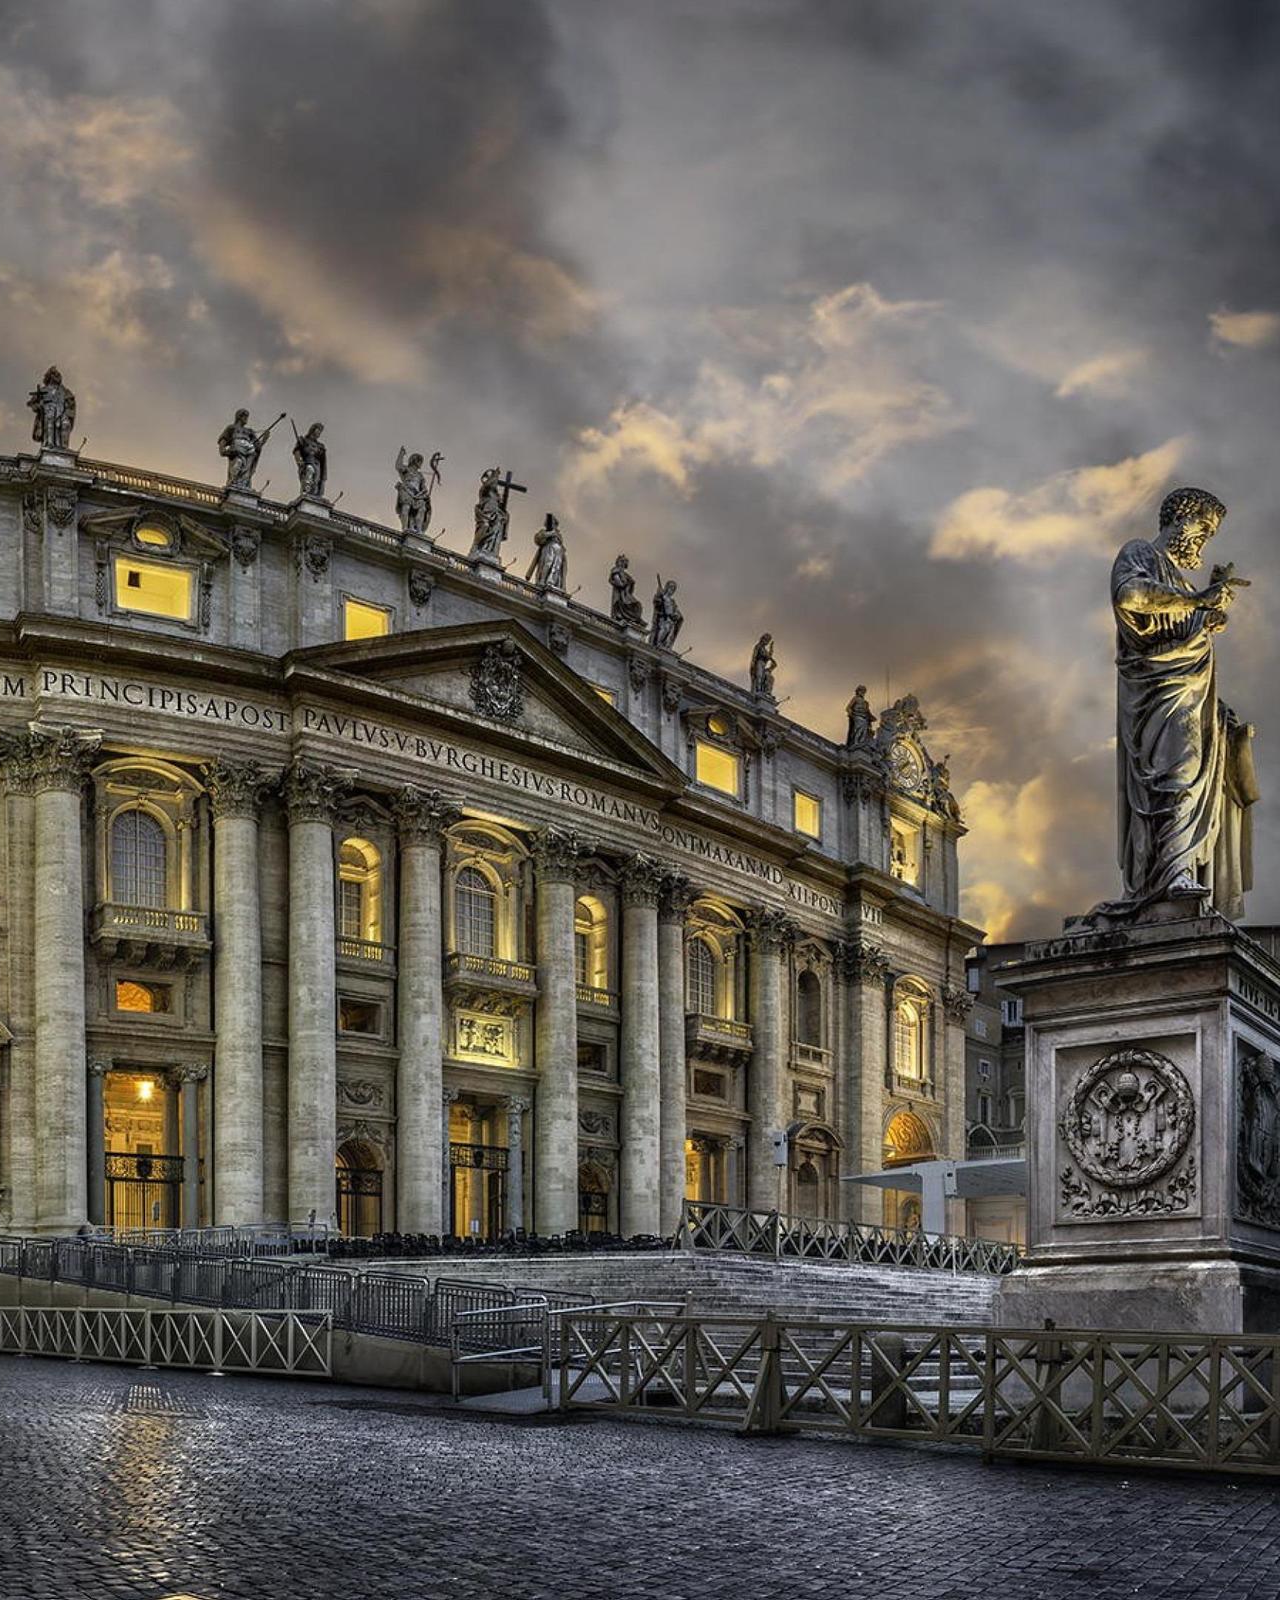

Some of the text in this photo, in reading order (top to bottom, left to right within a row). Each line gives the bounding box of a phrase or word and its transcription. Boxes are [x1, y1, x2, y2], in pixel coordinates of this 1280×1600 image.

[43, 671, 198, 715] PRINCIPIS
[203, 699, 290, 732] APOST
[303, 708, 390, 749] PAVLVS
[415, 738, 554, 797] BVRGHESIVS
[560, 782, 660, 831] ROMANVS
[659, 825, 698, 852] ONT
